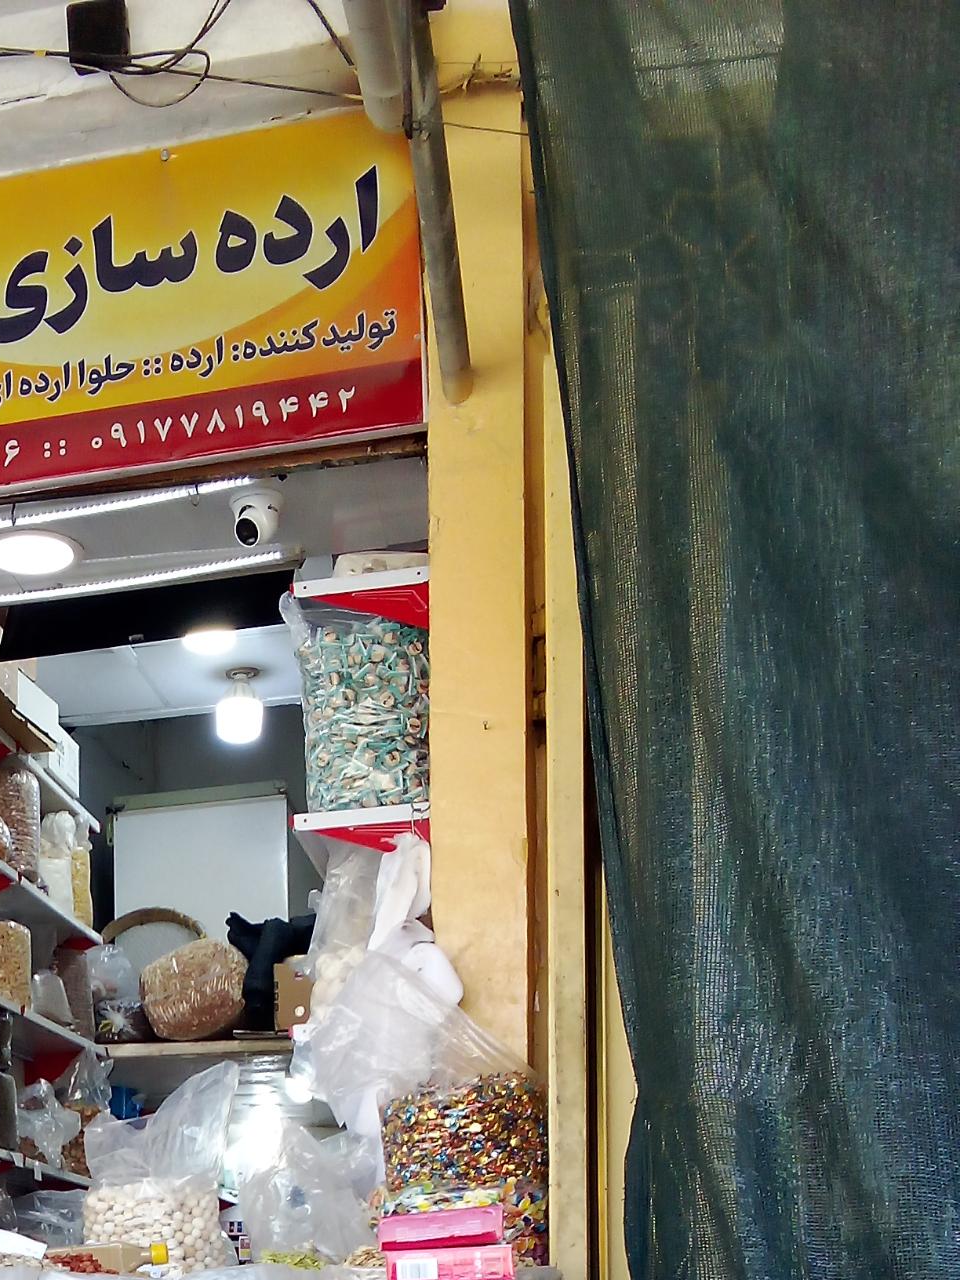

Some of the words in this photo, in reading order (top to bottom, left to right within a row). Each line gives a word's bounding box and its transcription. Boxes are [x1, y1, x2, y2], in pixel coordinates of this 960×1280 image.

[214, 165, 379, 290] ارده
[322, 308, 396, 352] تولید
[77, 354, 135, 395] حلوا
[169, 335, 225, 378] ارده
[19, 360, 71, 401] ارده
